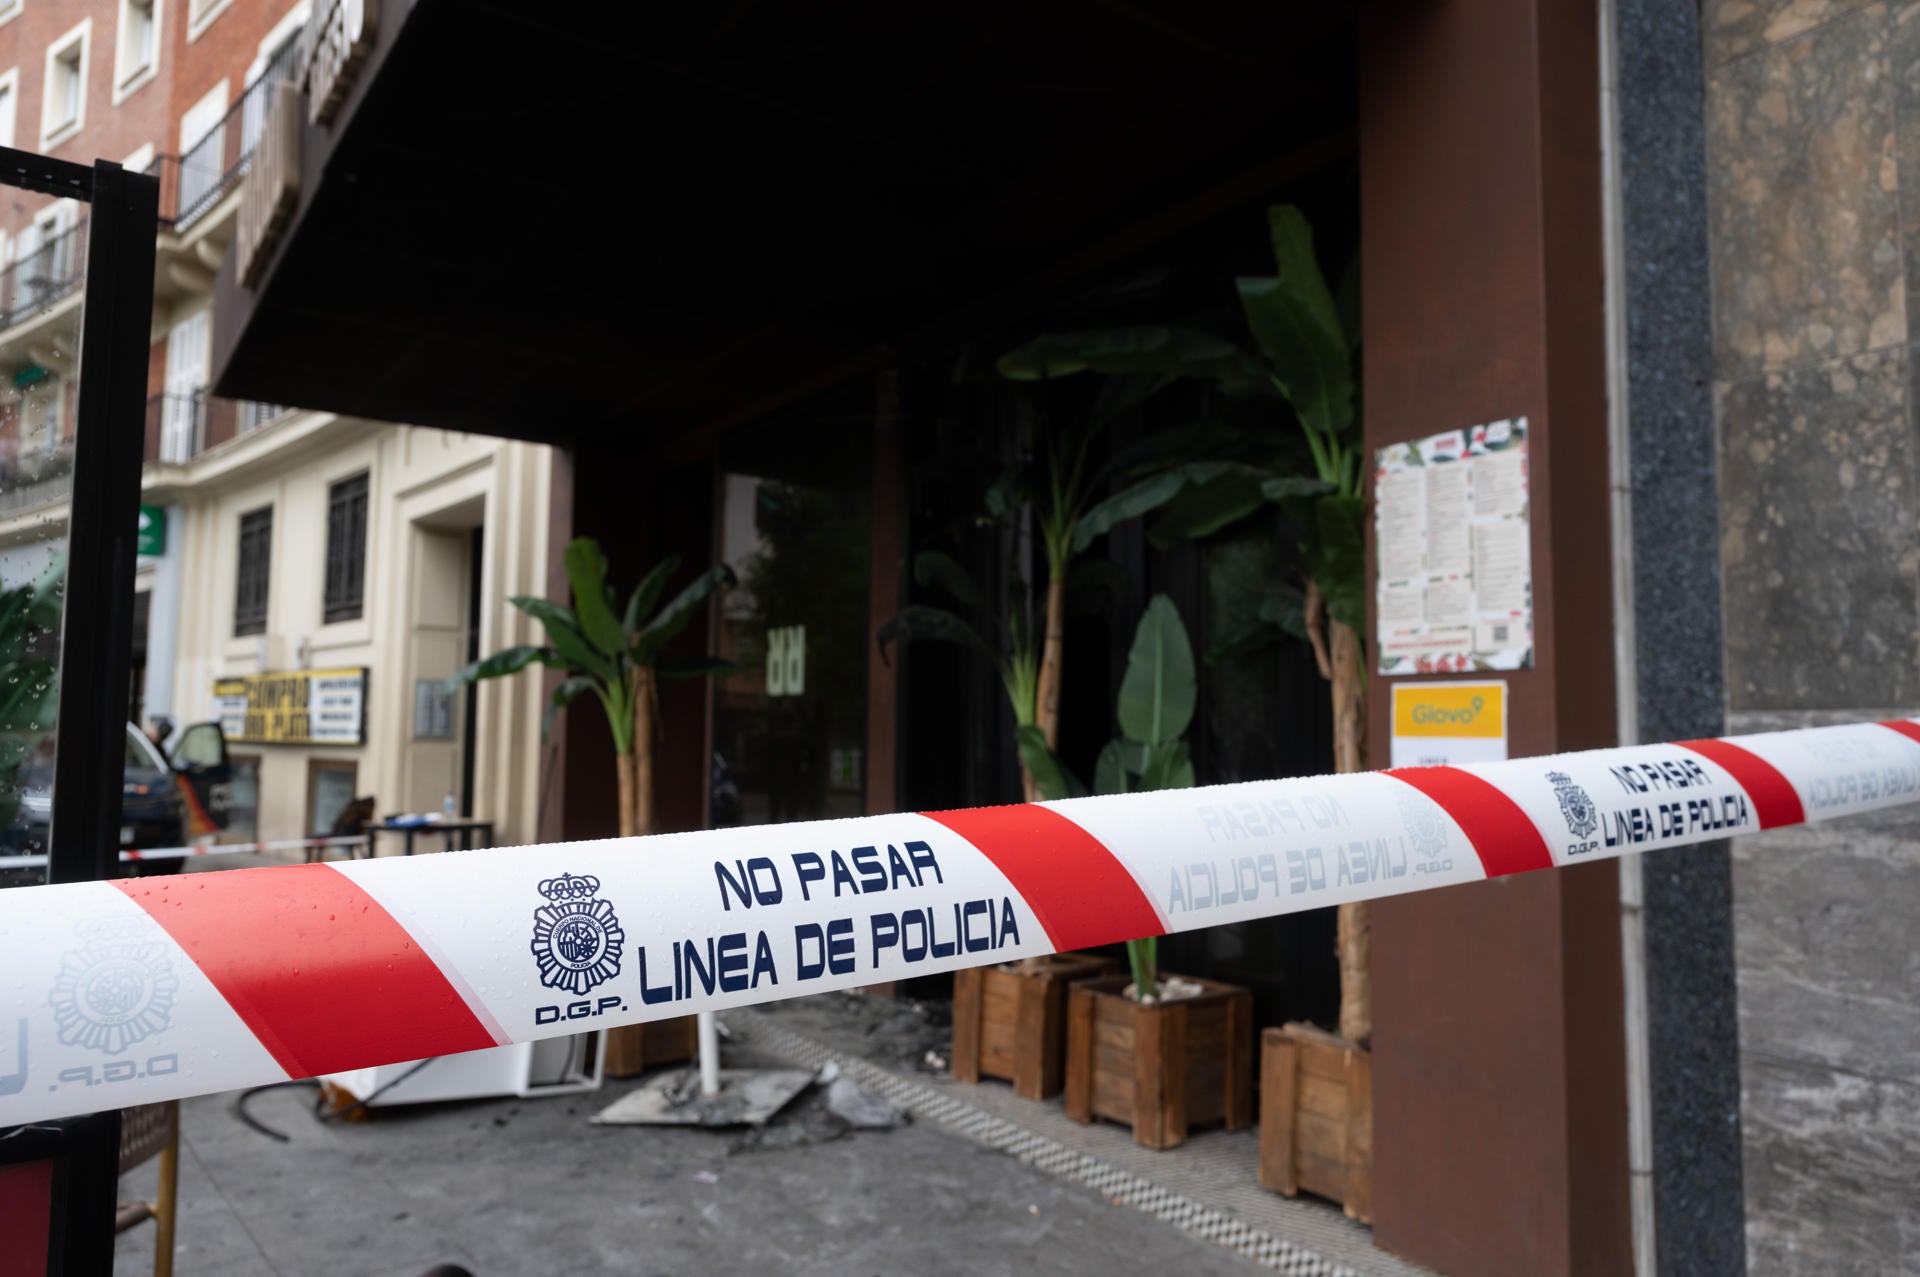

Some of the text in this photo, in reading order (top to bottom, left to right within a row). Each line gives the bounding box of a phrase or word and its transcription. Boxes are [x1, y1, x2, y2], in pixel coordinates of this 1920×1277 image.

[1412, 703, 1474, 725] Glovo
[1609, 759, 1712, 795] NO PASAR
[1602, 795, 1748, 847] LINEA DE POLICIA
[1567, 841, 1600, 856] D.G.P.
[713, 840, 944, 911] NO PASAR
[552, 915, 603, 939] CUERPO NACIONAL DE
[570, 961, 592, 969] POLICIA
[638, 896, 1021, 1006] LINEA DE POLICIA
[535, 995, 628, 1026] D.G.P.
